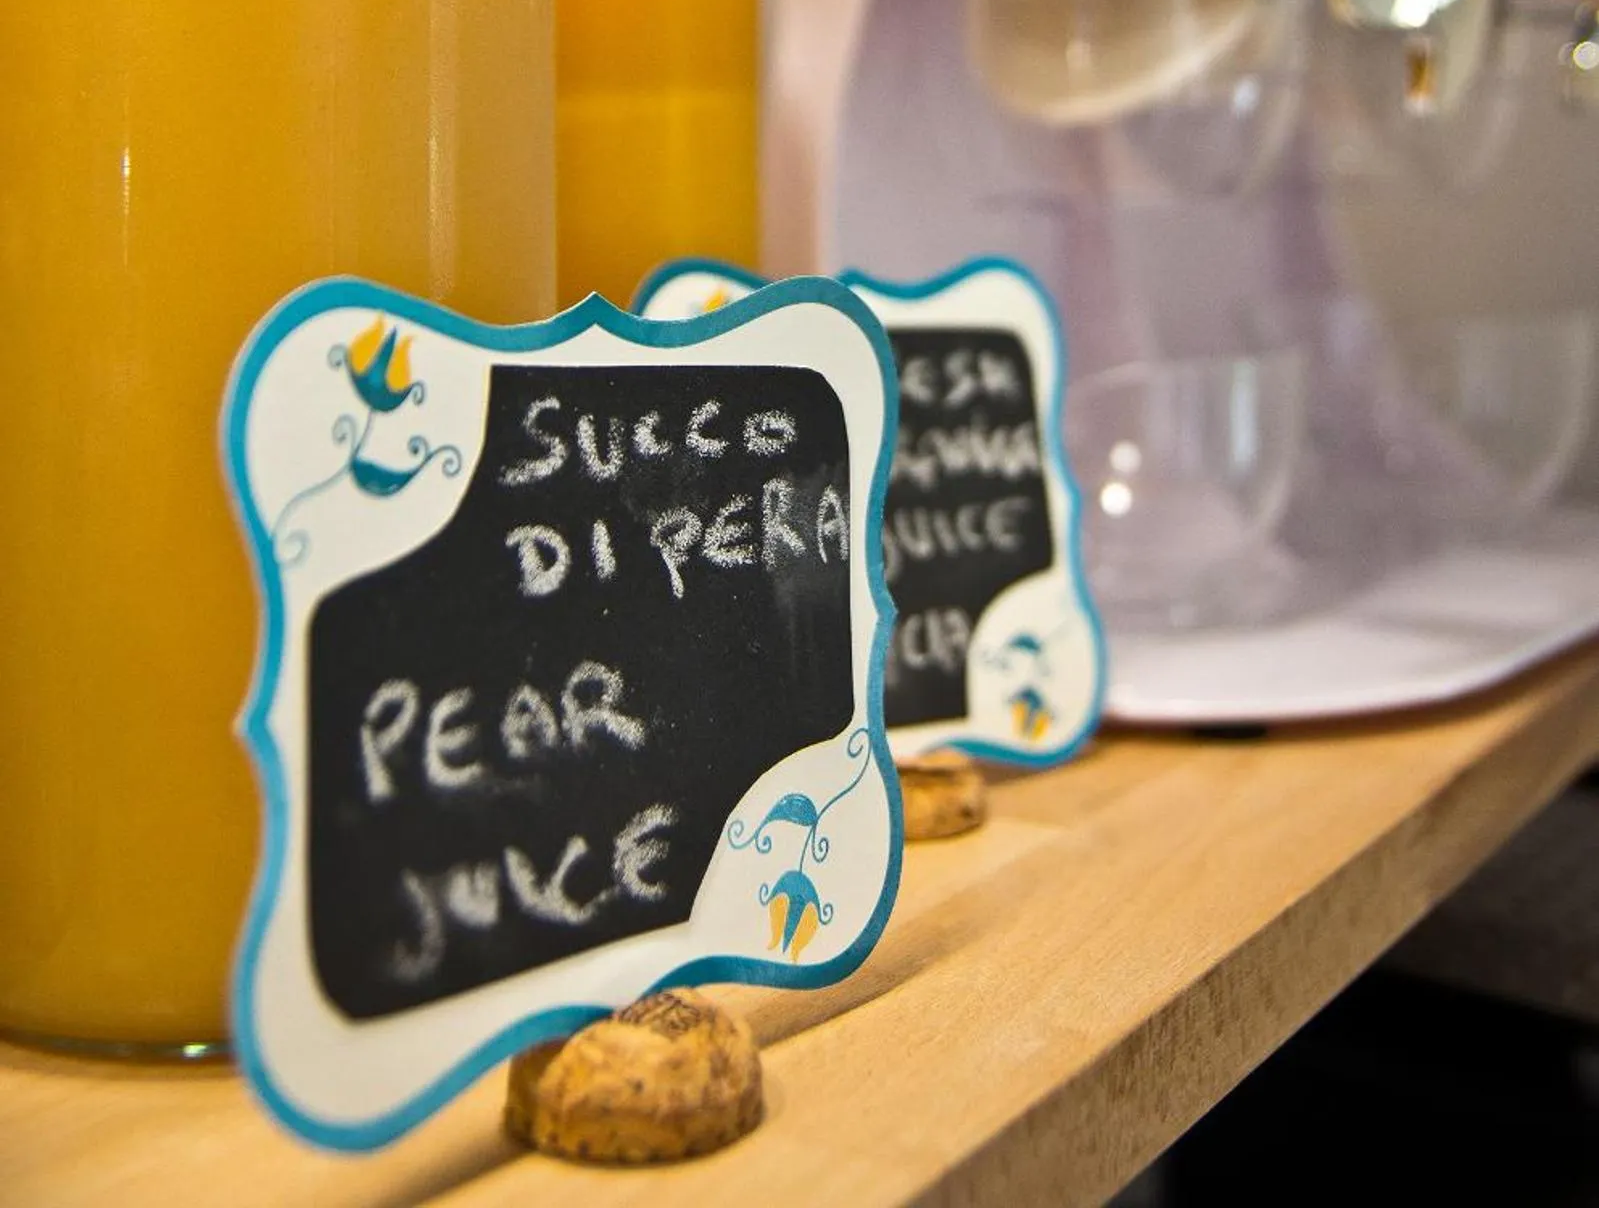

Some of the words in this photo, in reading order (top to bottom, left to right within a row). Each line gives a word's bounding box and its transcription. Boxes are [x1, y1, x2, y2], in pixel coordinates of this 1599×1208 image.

[500, 395, 798, 484] SUCCO
[505, 519, 616, 596] DI
[650, 477, 848, 598] PERA
[359, 660, 648, 803] PEAR
[390, 802, 678, 982] JUICE
